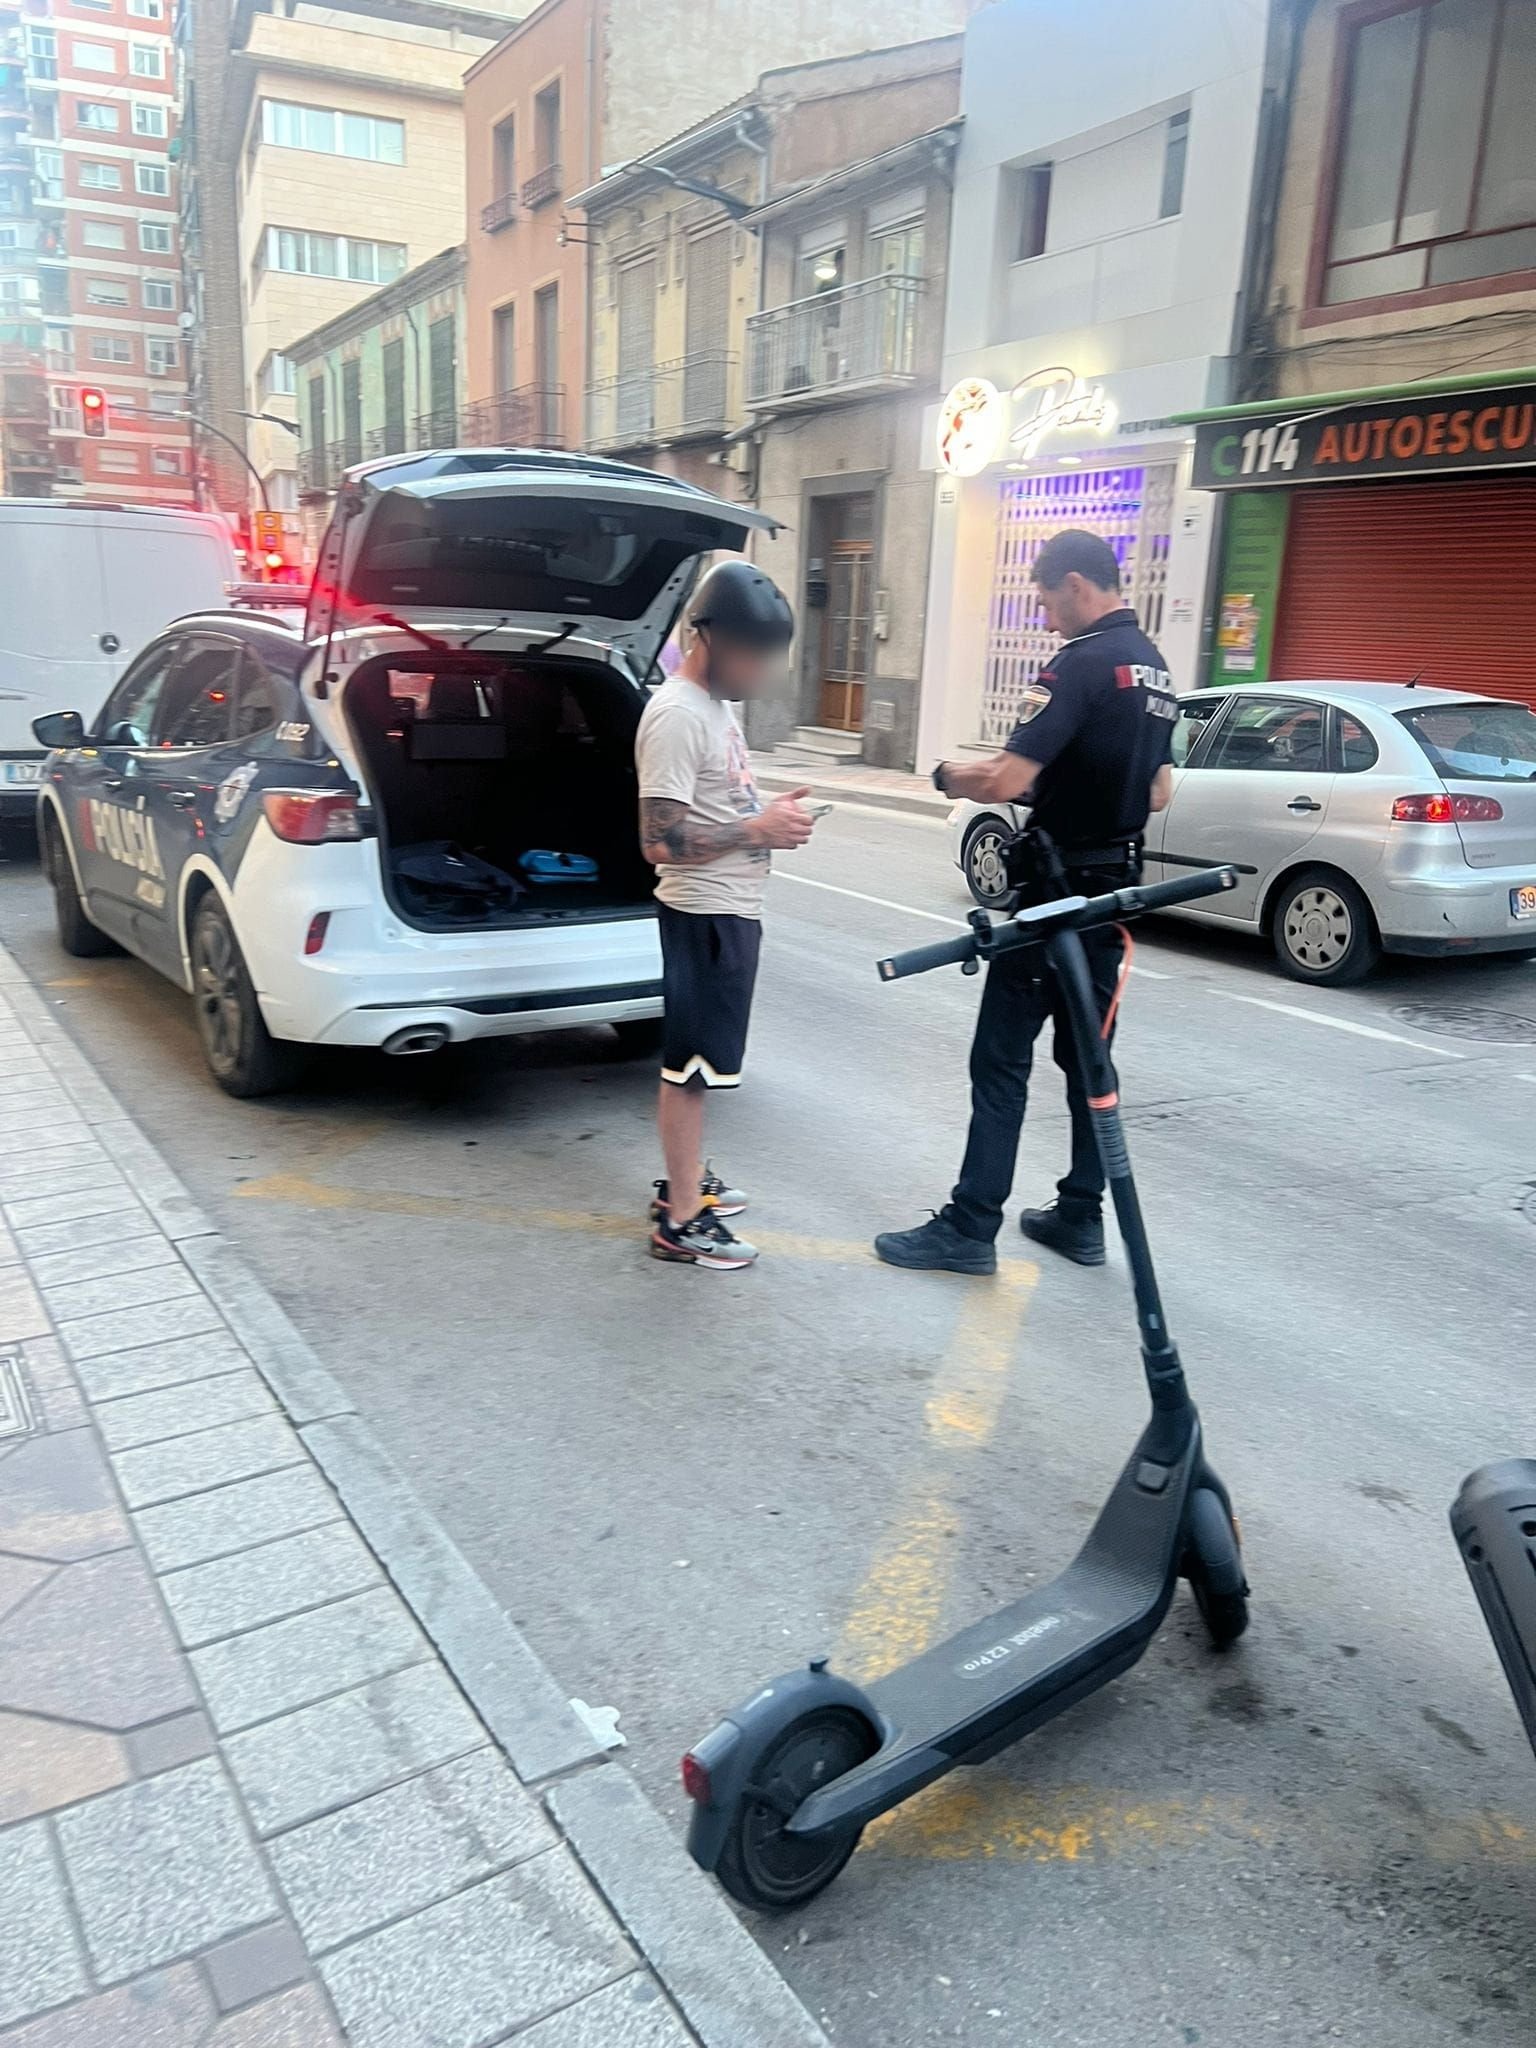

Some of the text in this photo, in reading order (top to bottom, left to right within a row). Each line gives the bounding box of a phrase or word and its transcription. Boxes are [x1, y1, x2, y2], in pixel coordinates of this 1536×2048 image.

[1210, 403, 1536, 477] C114 AUTOESCU
[1520, 891, 1536, 910] 39
[986, 1645, 1011, 1659] E2
[963, 1655, 993, 1671] Pro
